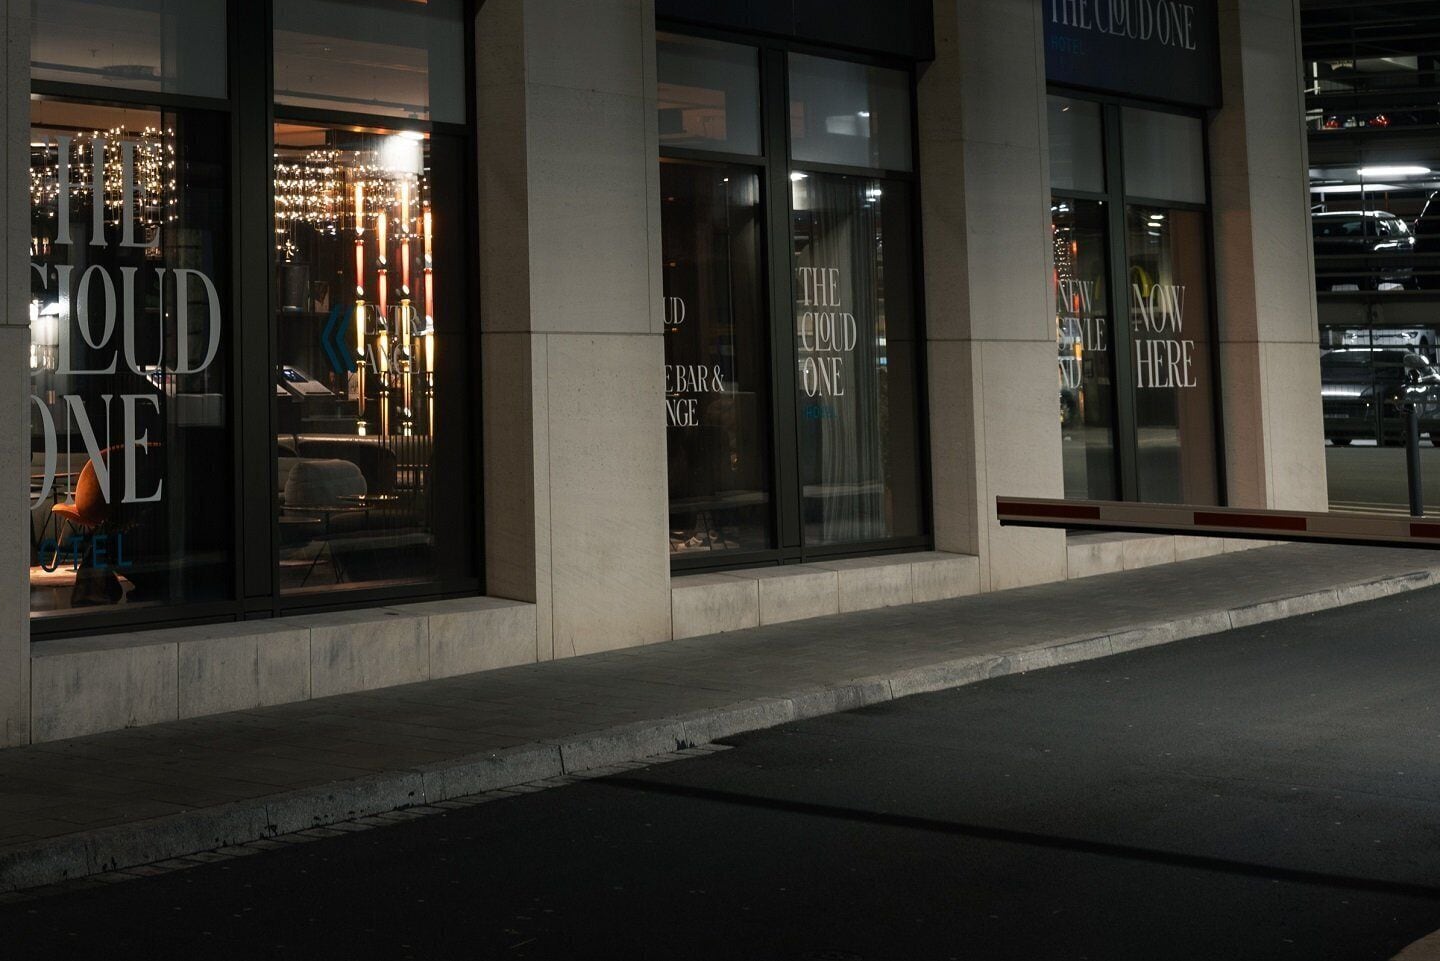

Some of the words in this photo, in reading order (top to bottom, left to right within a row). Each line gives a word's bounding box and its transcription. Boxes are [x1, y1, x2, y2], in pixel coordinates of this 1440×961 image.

[799, 267, 841, 307] THE
[1132, 283, 1186, 333] NOW
[801, 312, 857, 352] CLOUD
[676, 365, 709, 392] BAR
[712, 364, 725, 392] &
[803, 356, 845, 397] ONE
[1135, 339, 1197, 388] HERE
[36, 529, 133, 573] OTEL
